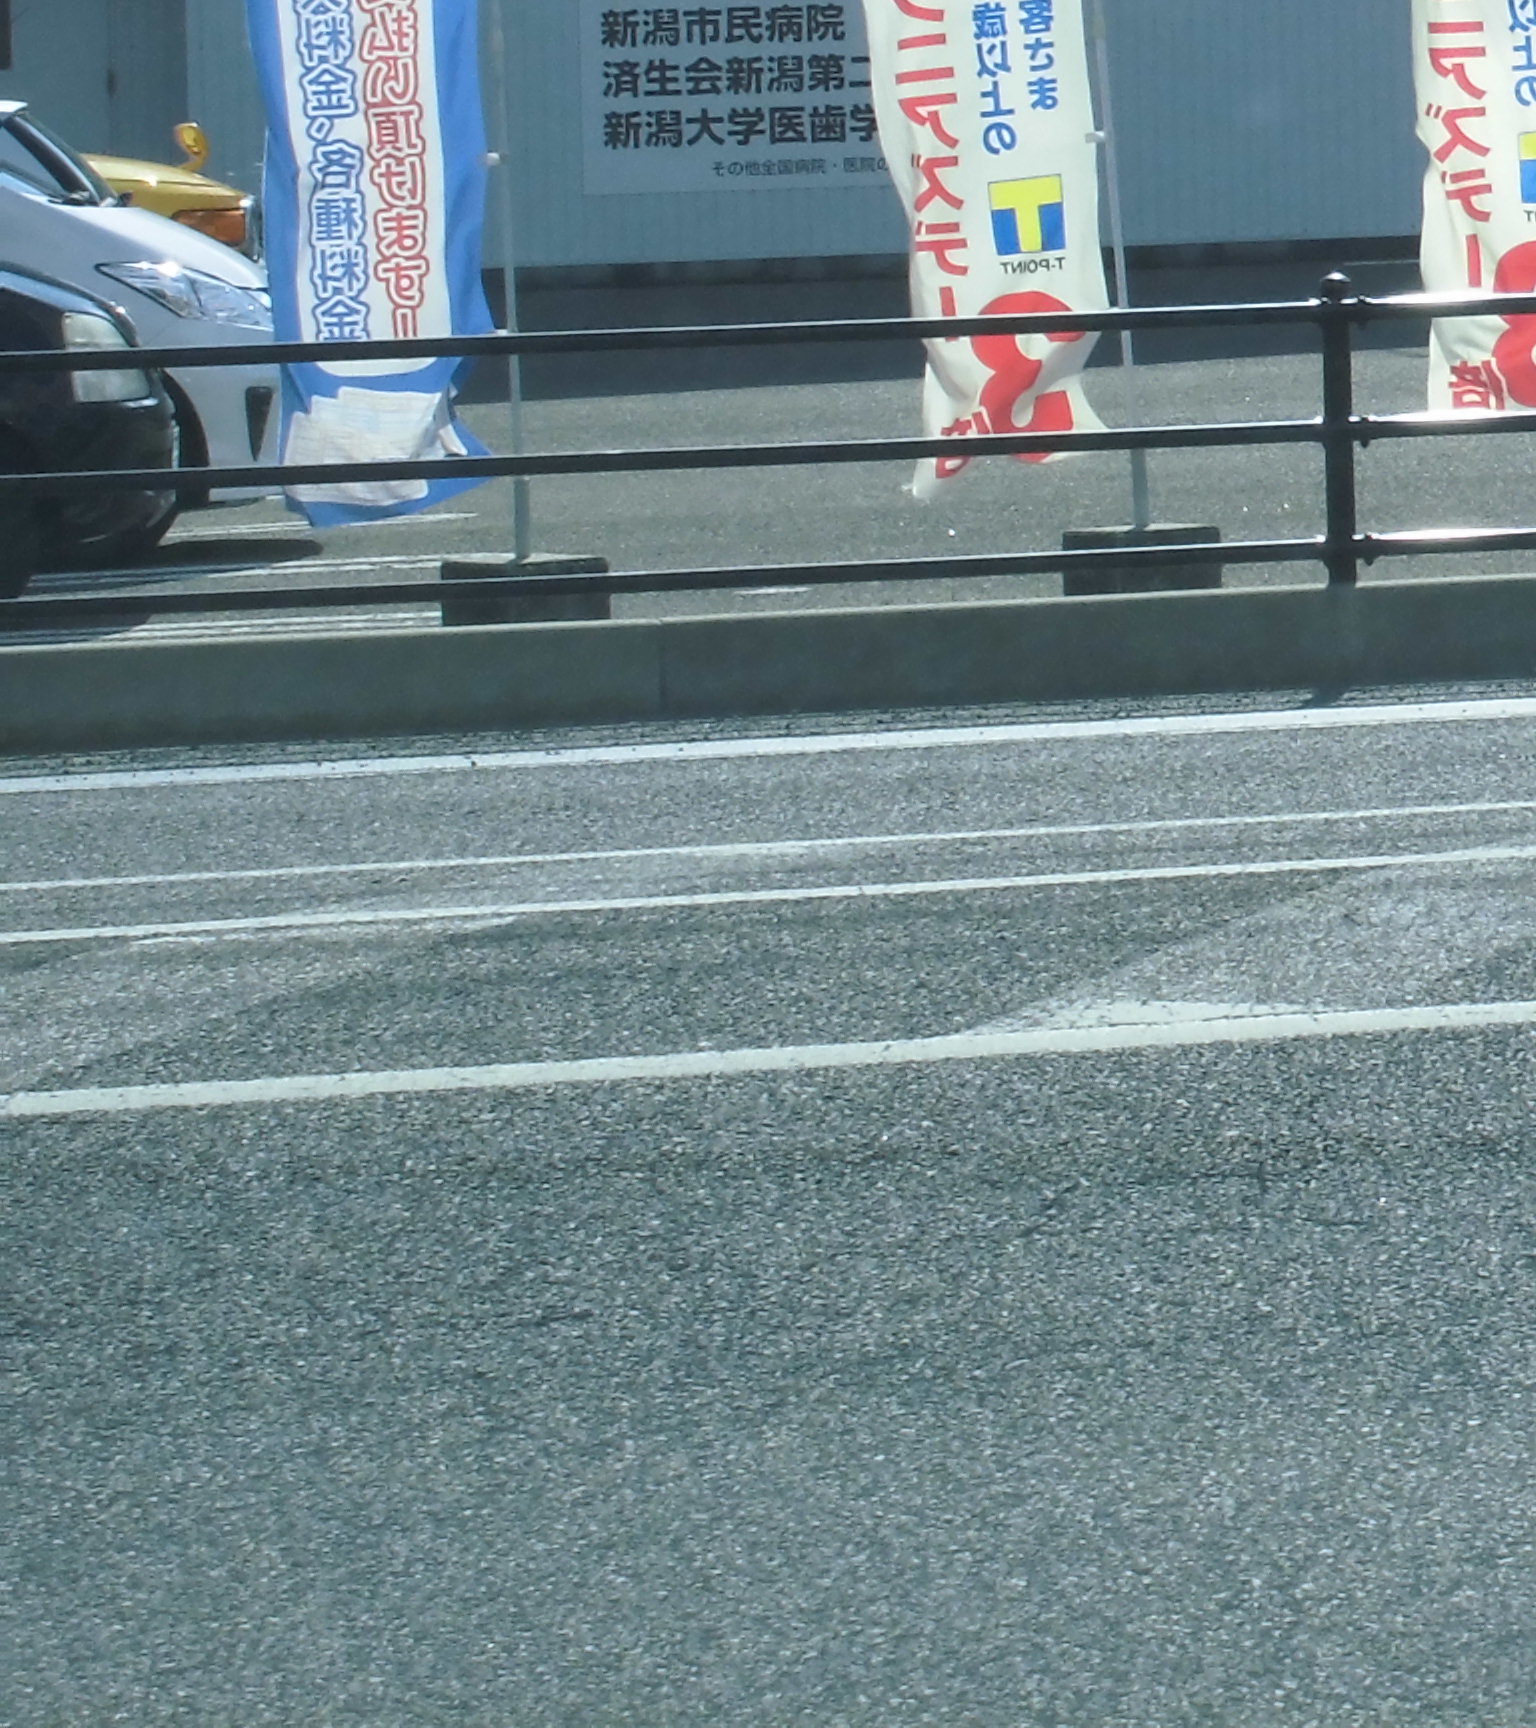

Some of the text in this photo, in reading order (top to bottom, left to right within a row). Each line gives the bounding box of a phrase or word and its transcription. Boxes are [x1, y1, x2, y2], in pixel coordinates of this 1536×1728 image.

[600, 3, 846, 48] 新潟市民病院
